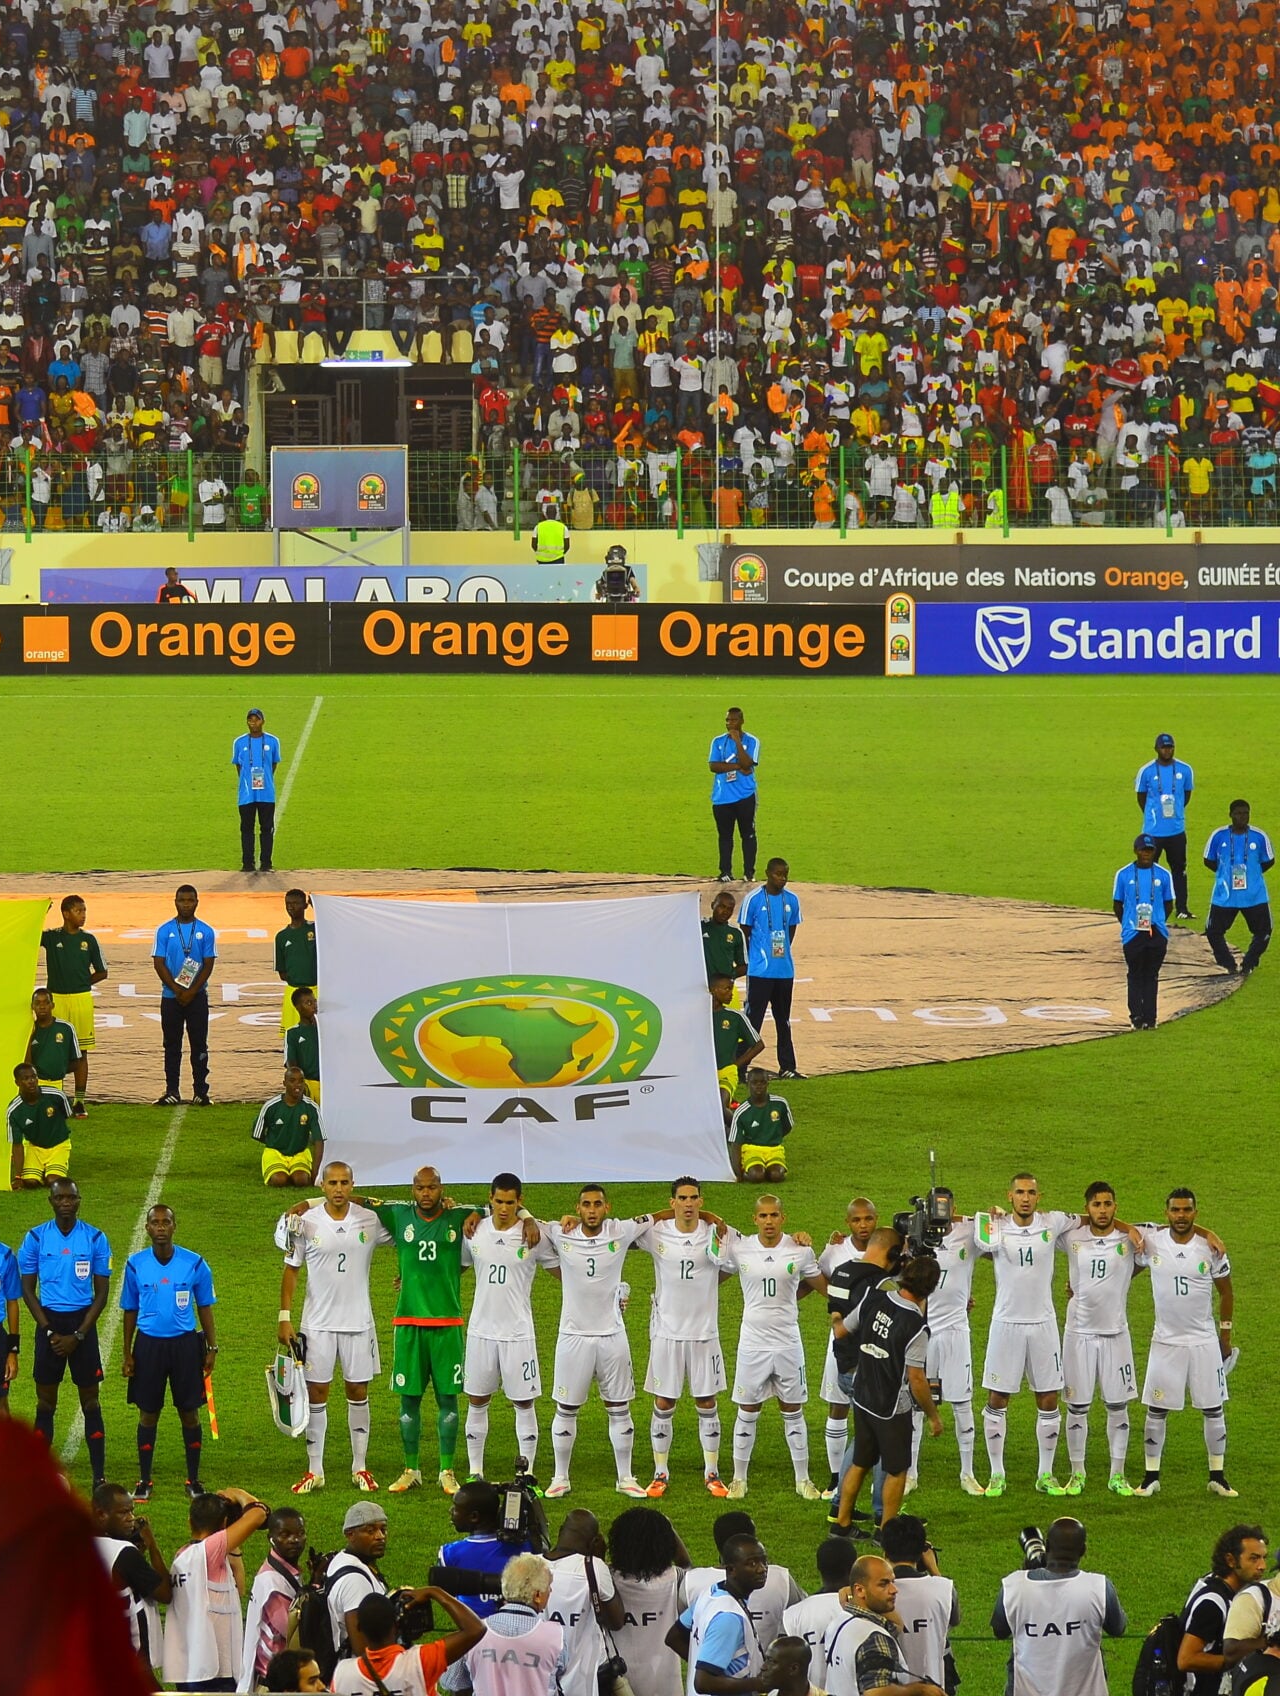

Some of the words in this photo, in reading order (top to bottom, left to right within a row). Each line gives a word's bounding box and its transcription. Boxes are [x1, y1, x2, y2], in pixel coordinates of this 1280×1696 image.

[784, 568, 855, 591] Coupe
[966, 567, 1005, 587] des
[1014, 567, 1096, 587] Nations
[1104, 566, 1189, 591] Orange,
[1198, 562, 1260, 587] GUINÉE
[90, 611, 295, 667] Orange
[363, 609, 569, 666] Orange
[659, 610, 865, 668] Orange
[1048, 615, 1261, 660] Standard
[25, 650, 64, 660] orange
[594, 648, 633, 659] orange
[410, 1089, 631, 1124] CAF
[418, 1240, 437, 1261] 23
[1019, 1247, 1033, 1267] 14
[337, 1253, 346, 1273] 2
[586, 1258, 595, 1277] 3
[679, 1260, 694, 1280] 12
[1091, 1259, 1107, 1279] 19
[488, 1264, 507, 1285] 20
[762, 1277, 776, 1297] 10
[1174, 1276, 1189, 1297] 15
[871, 1320, 889, 1339] 013
[453, 1363, 464, 1385] 2
[522, 1359, 536, 1381] 20
[965, 1363, 971, 1385] 7
[1119, 1365, 1133, 1384] 19
[549, 1611, 582, 1627] AF
[623, 1612, 658, 1627] AF
[1024, 1620, 1081, 1638] CAF
